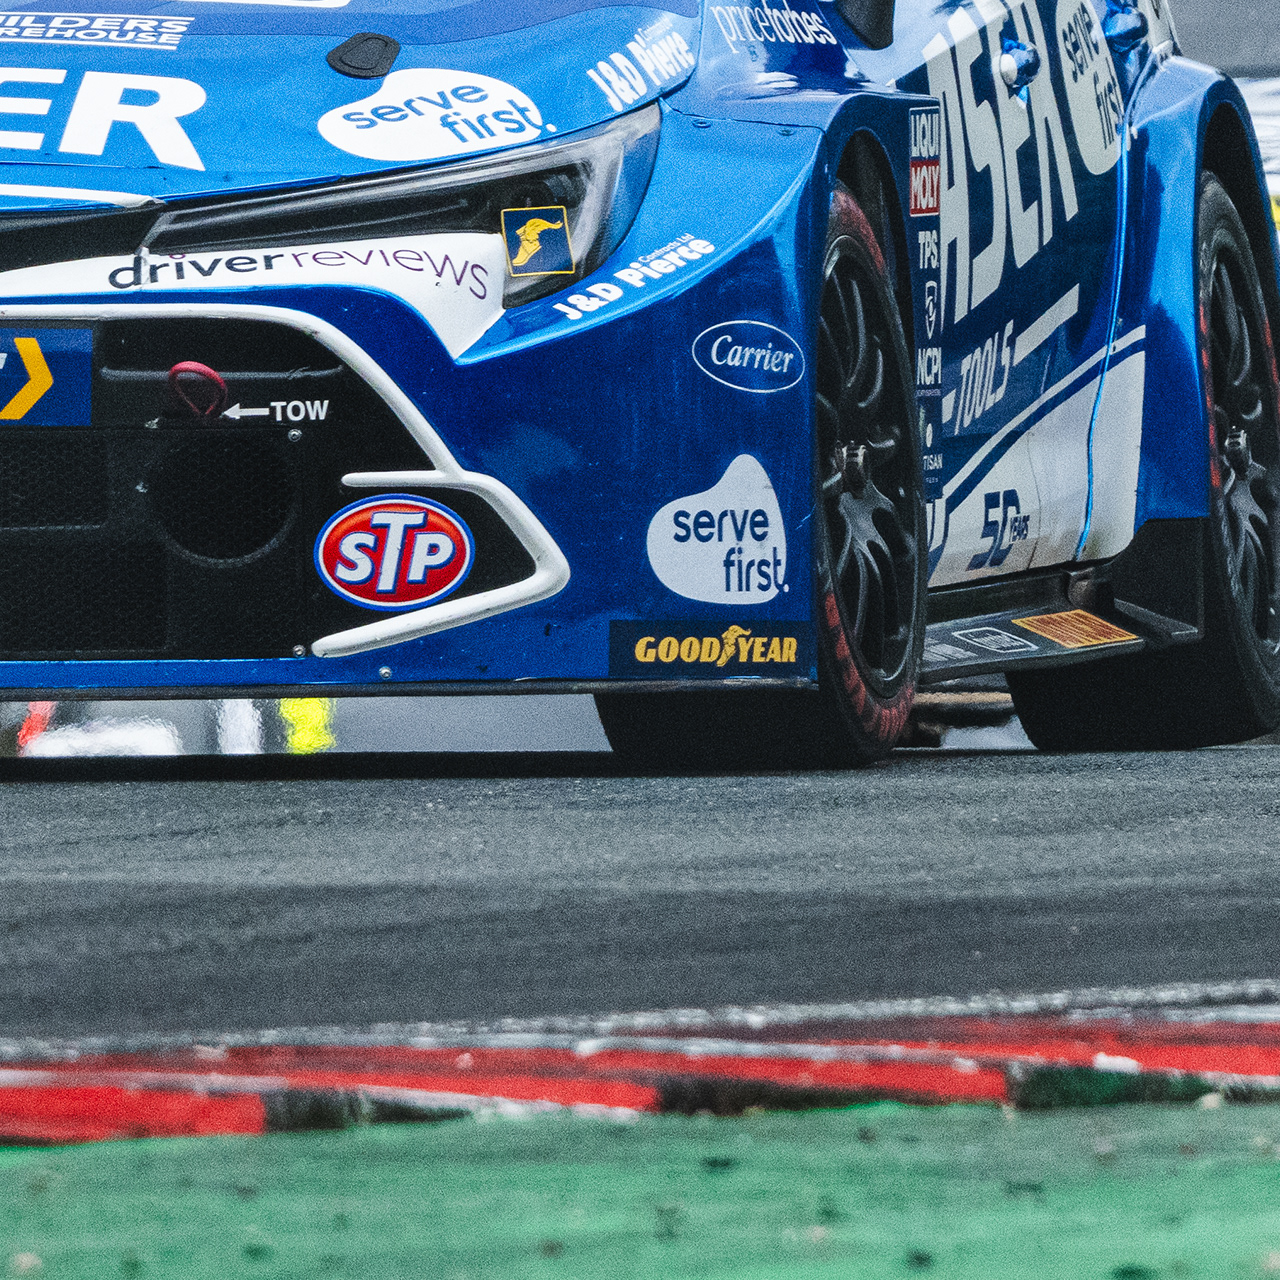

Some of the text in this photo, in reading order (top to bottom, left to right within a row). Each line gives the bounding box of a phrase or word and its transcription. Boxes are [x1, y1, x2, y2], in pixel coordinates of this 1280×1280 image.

[1062, 2, 1100, 83] serve
[586, 31, 695, 112] J&D Pierce
[342, 85, 489, 129] serve
[911, 166, 939, 210] MOLY
[638, 232, 695, 263] Contracts Ltd
[552, 237, 715, 320] J&D Pierce
[711, 334, 794, 373] Carrier
[954, 320, 1014, 436] TOOLS
[270, 399, 329, 421] TOW
[673, 506, 769, 544] serve
[334, 511, 456, 594] STP
